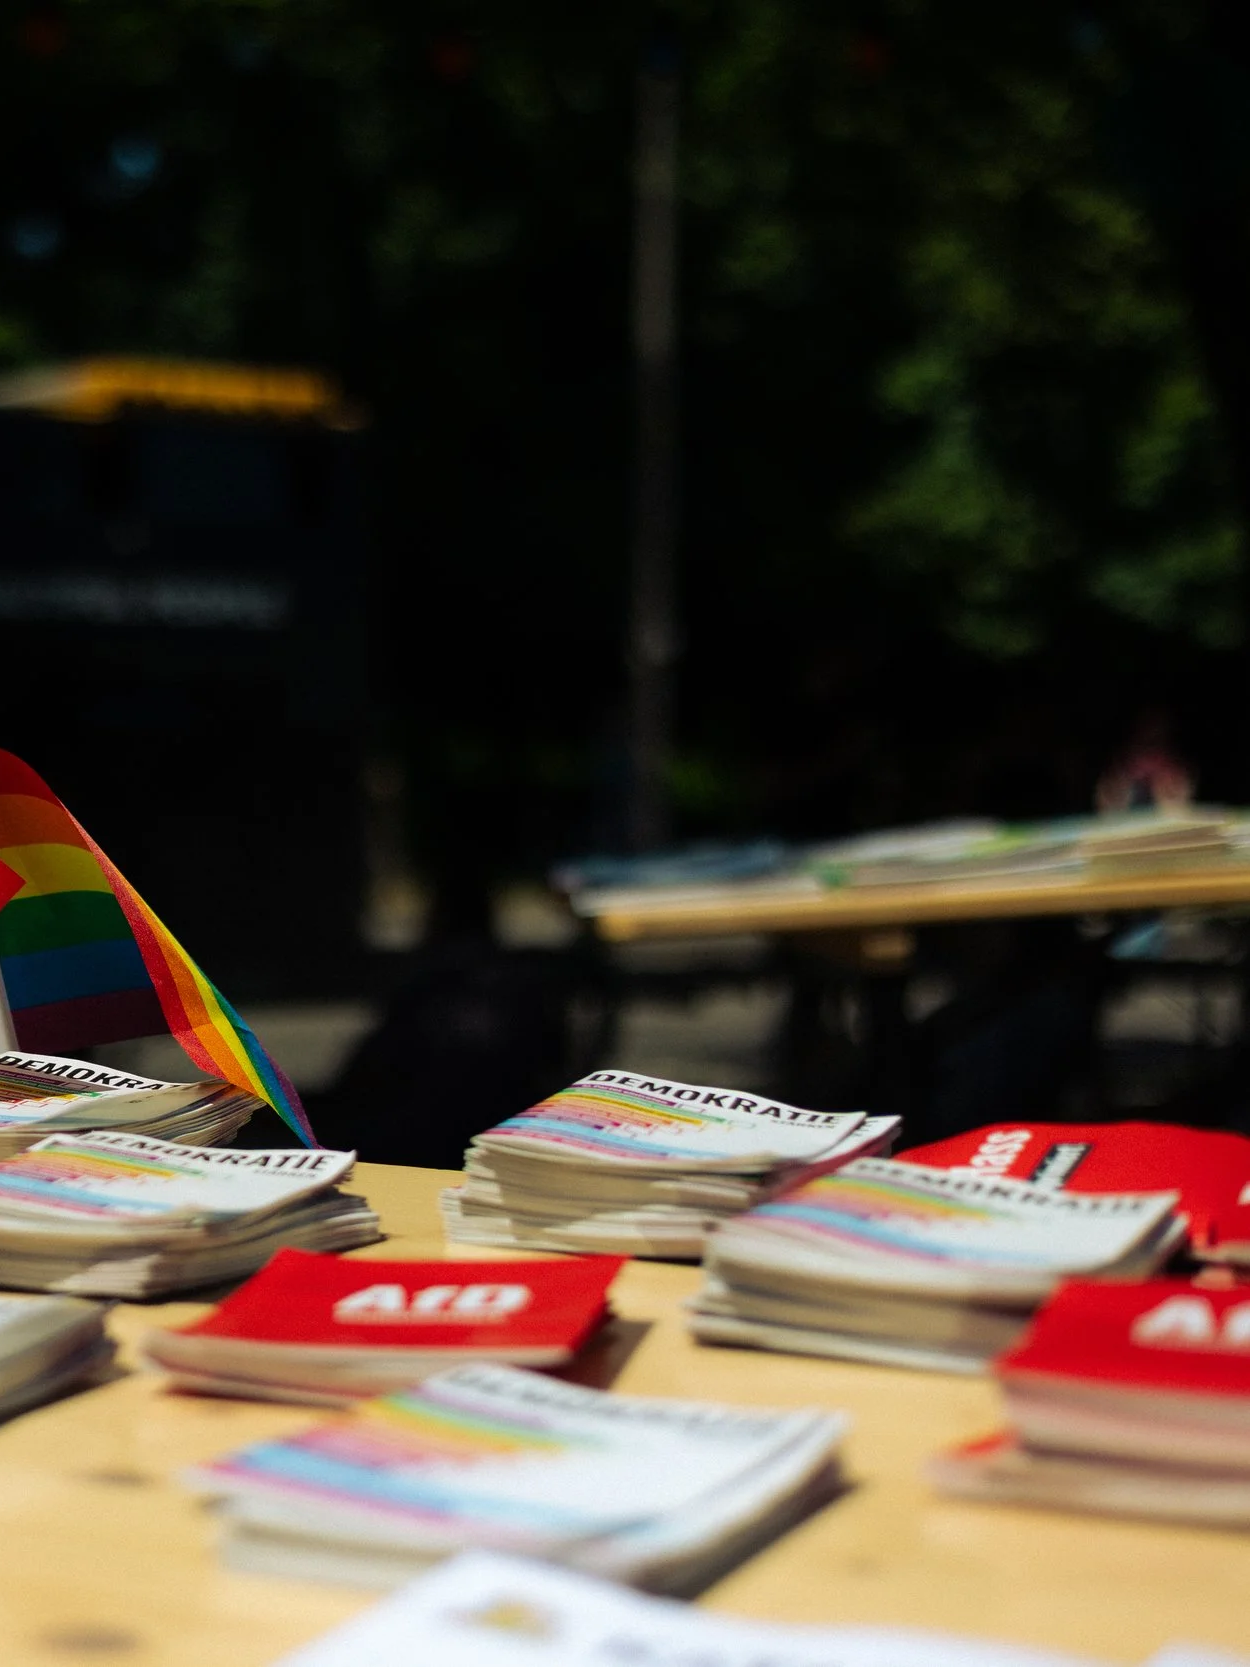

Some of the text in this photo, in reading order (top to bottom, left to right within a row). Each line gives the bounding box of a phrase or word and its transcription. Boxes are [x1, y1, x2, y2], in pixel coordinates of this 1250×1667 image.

[589, 1073, 840, 1126] DEMOKRATIE
[81, 1131, 336, 1172] DEMOKRATIE
[332, 1283, 532, 1325] AfD
